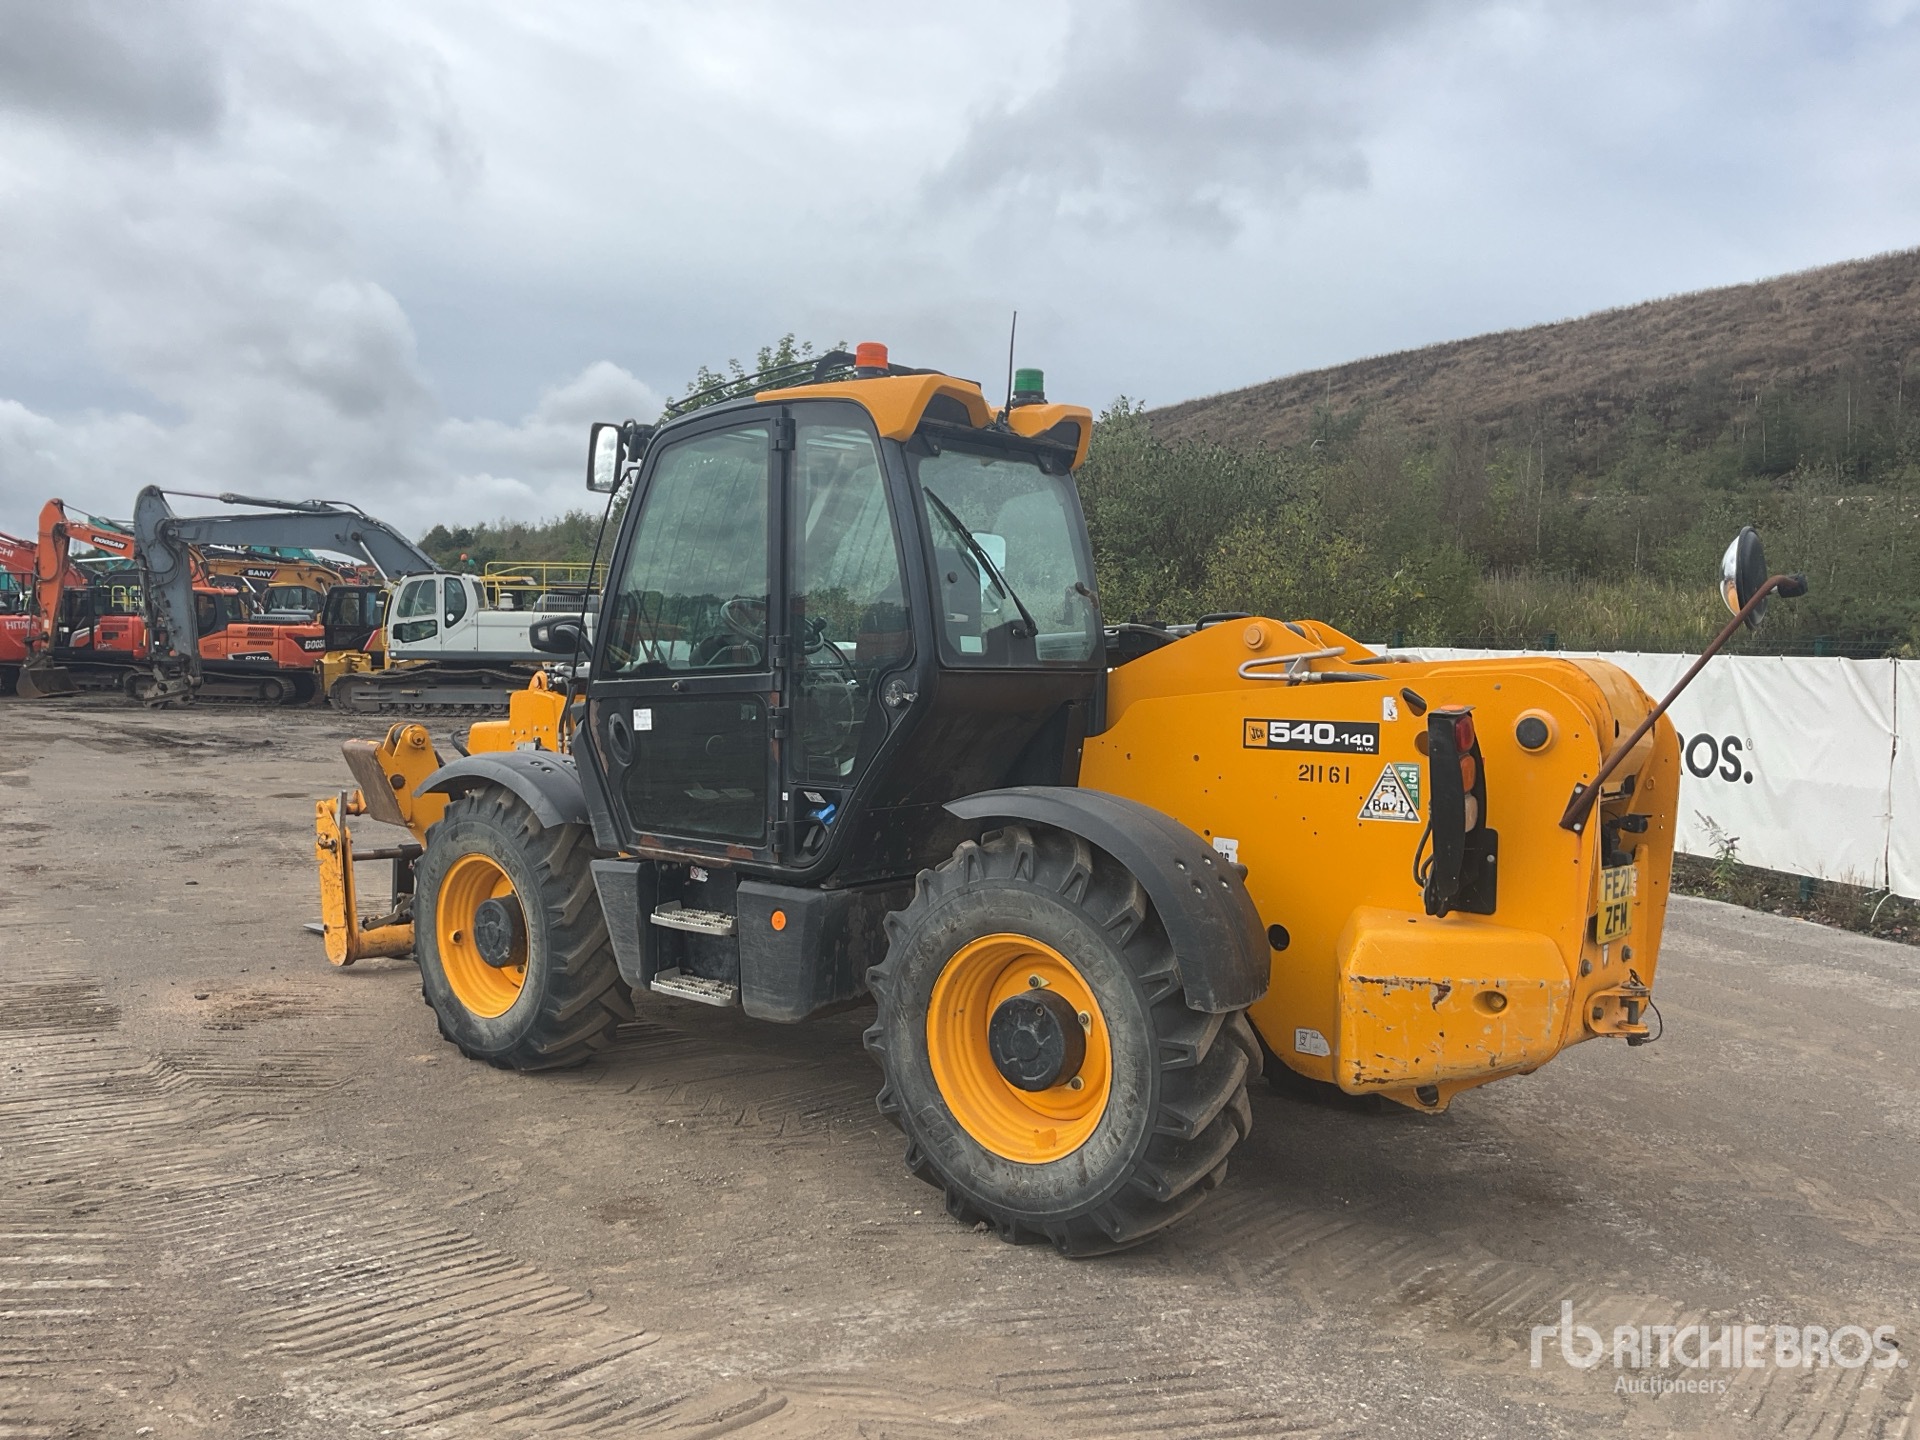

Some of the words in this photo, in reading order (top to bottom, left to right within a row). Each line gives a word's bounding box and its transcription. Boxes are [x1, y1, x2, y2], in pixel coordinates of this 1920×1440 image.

[94, 536, 125, 549] DOOSAN
[1249, 726, 1265, 741] JCB
[1298, 764, 1350, 785] 21161
[1408, 771, 1418, 784] 5
[1604, 867, 1630, 902] FE21
[1604, 901, 1628, 936] ZFM
